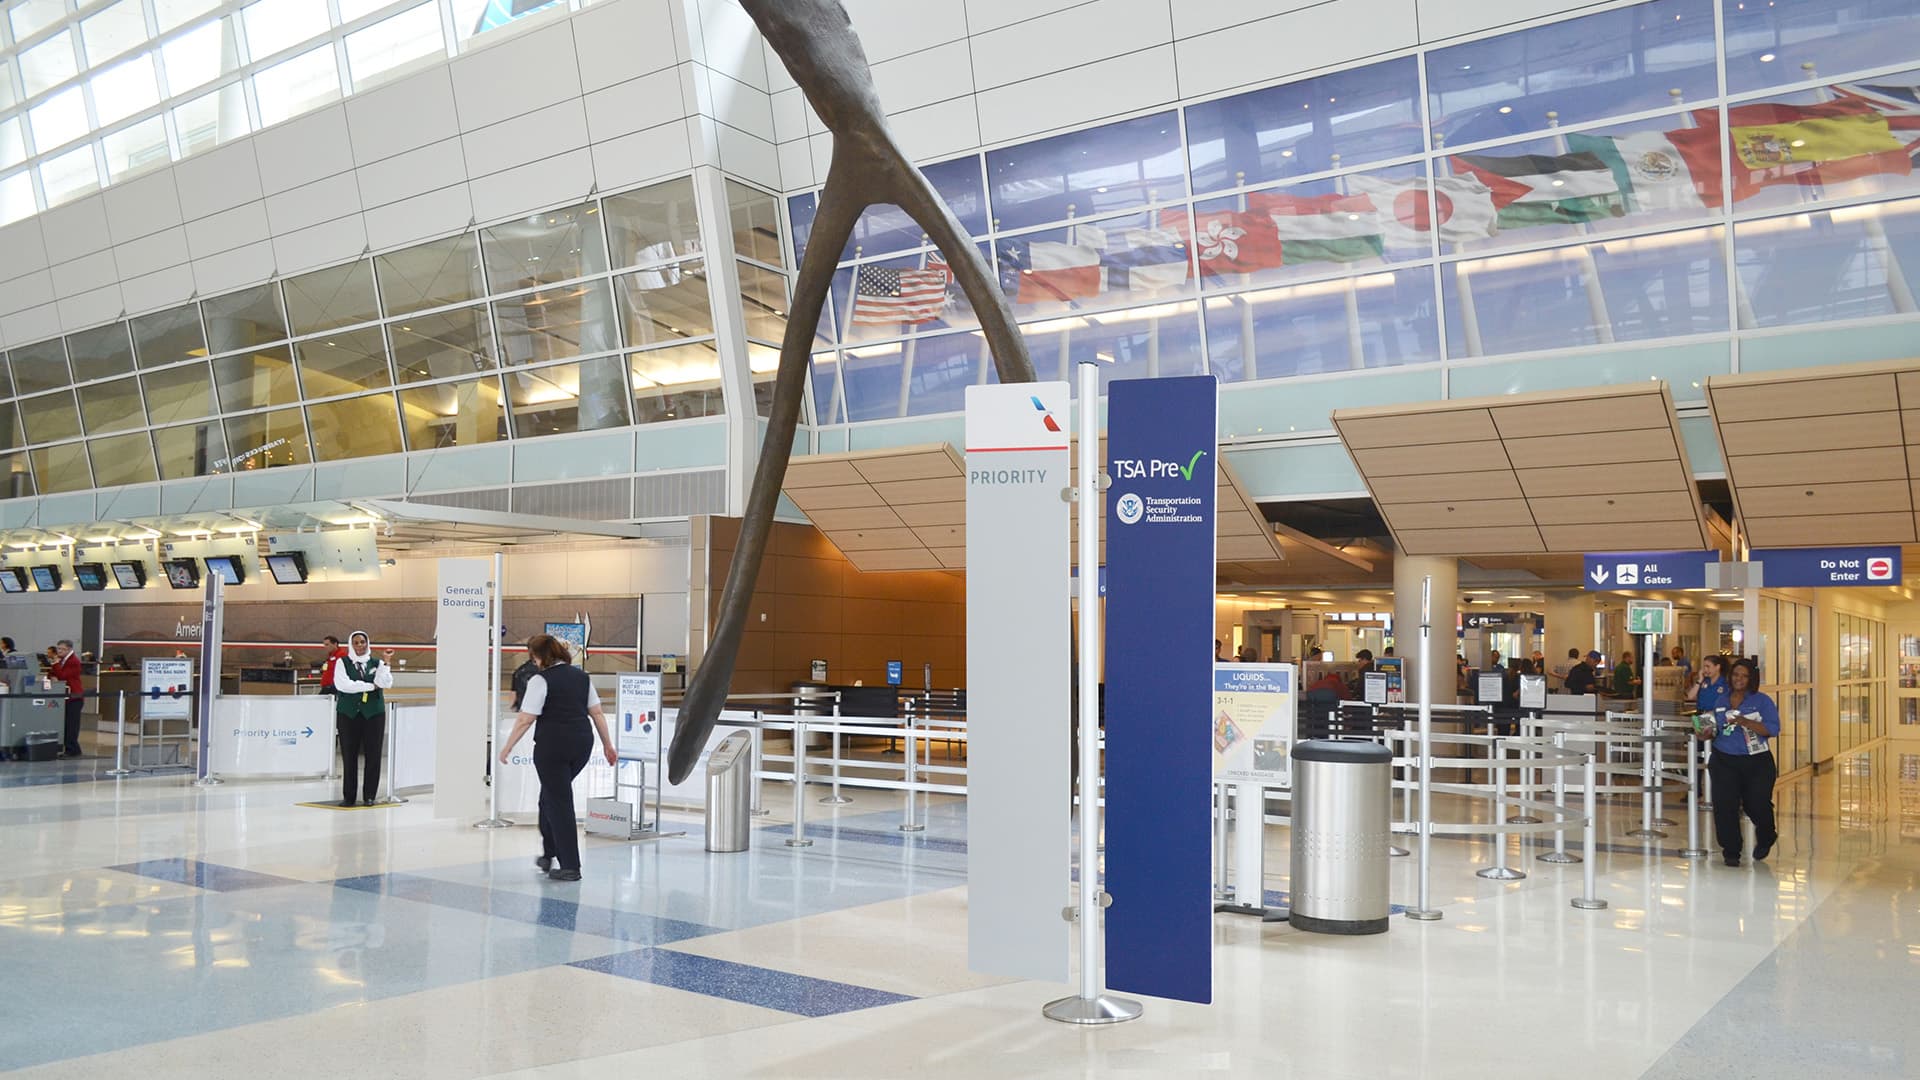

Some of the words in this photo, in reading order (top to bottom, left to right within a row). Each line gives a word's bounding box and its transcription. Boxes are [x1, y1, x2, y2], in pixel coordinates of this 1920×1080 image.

[1113, 459, 1147, 479] TSA
[1150, 459, 1179, 478] Pre
[971, 469, 1047, 484] PRIORITY
[1145, 496, 1202, 507] Transportation
[1145, 506, 1178, 515] Security
[1145, 514, 1203, 523] Administration
[1643, 563, 1658, 573] All
[1820, 559, 1836, 569] Do
[1839, 559, 1860, 568] Not
[1643, 575, 1672, 585] Gates
[1830, 572, 1860, 581] Enter
[446, 585, 483, 595] General
[442, 598, 486, 610] Boarding
[1641, 611, 1652, 631] 1
[175, 621, 202, 637] Ameri
[233, 728, 270, 739] Pority
[272, 729, 297, 737] Lines
